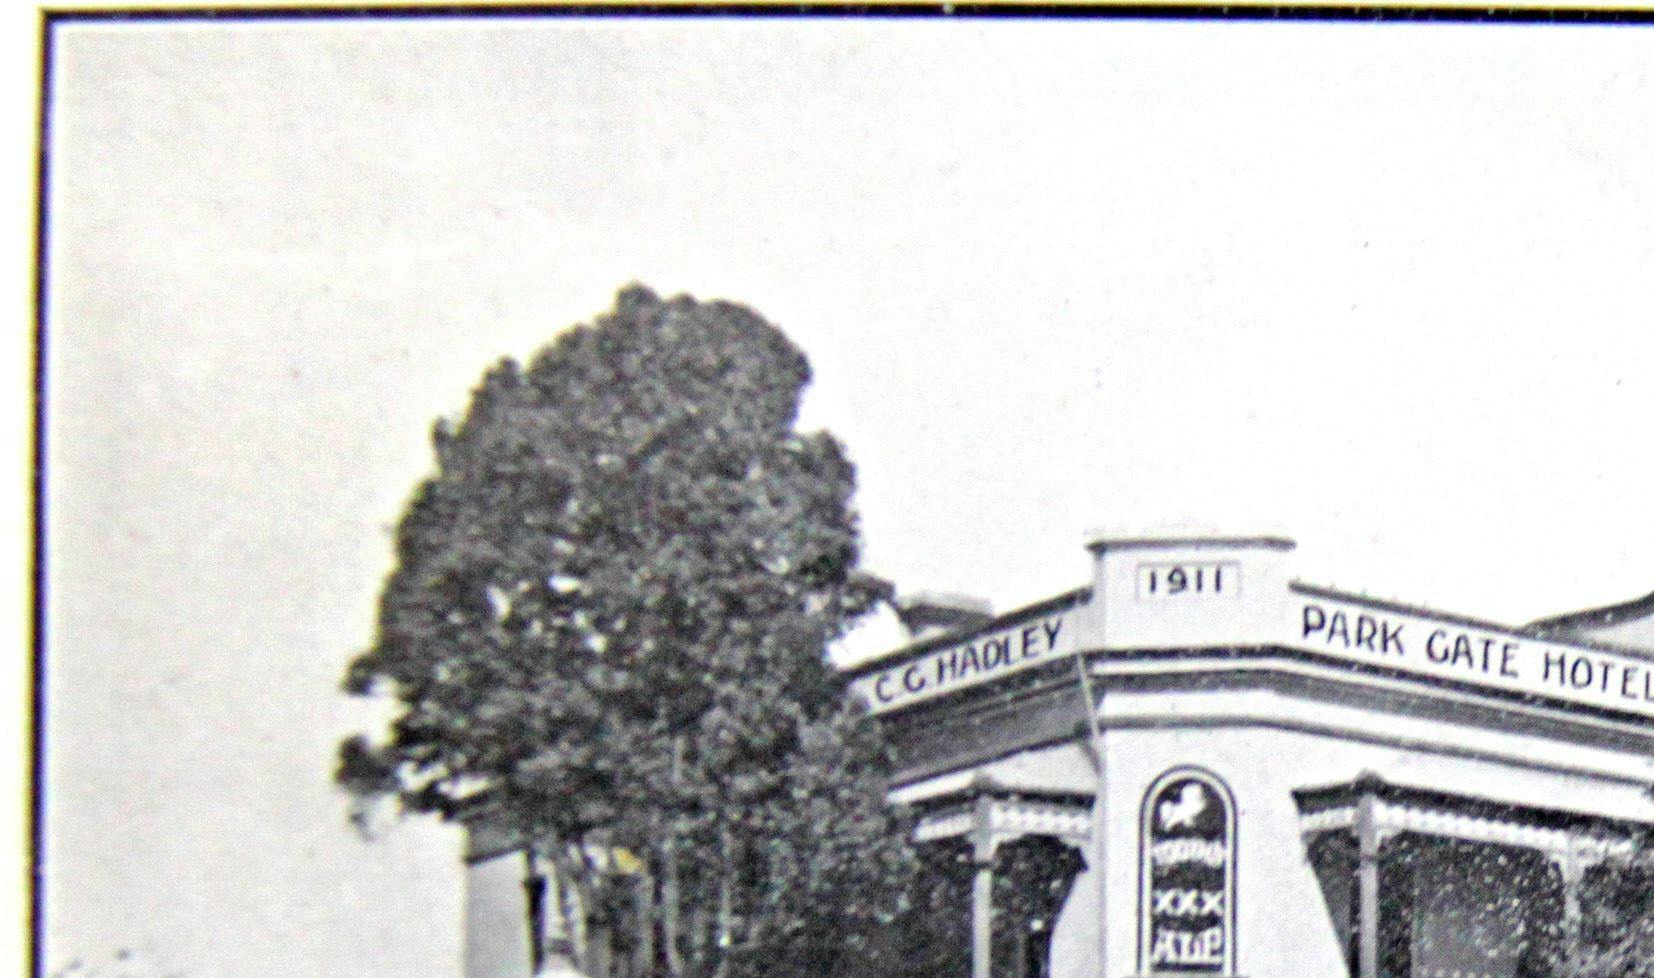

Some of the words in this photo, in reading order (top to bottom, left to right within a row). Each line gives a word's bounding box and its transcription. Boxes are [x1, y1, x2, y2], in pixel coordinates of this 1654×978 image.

[1147, 566, 1224, 595] 1911
[936, 617, 1064, 686] HADLEY
[1301, 604, 1405, 656] PARK
[1425, 629, 1520, 679] GATE
[1154, 887, 1223, 915] XXX
